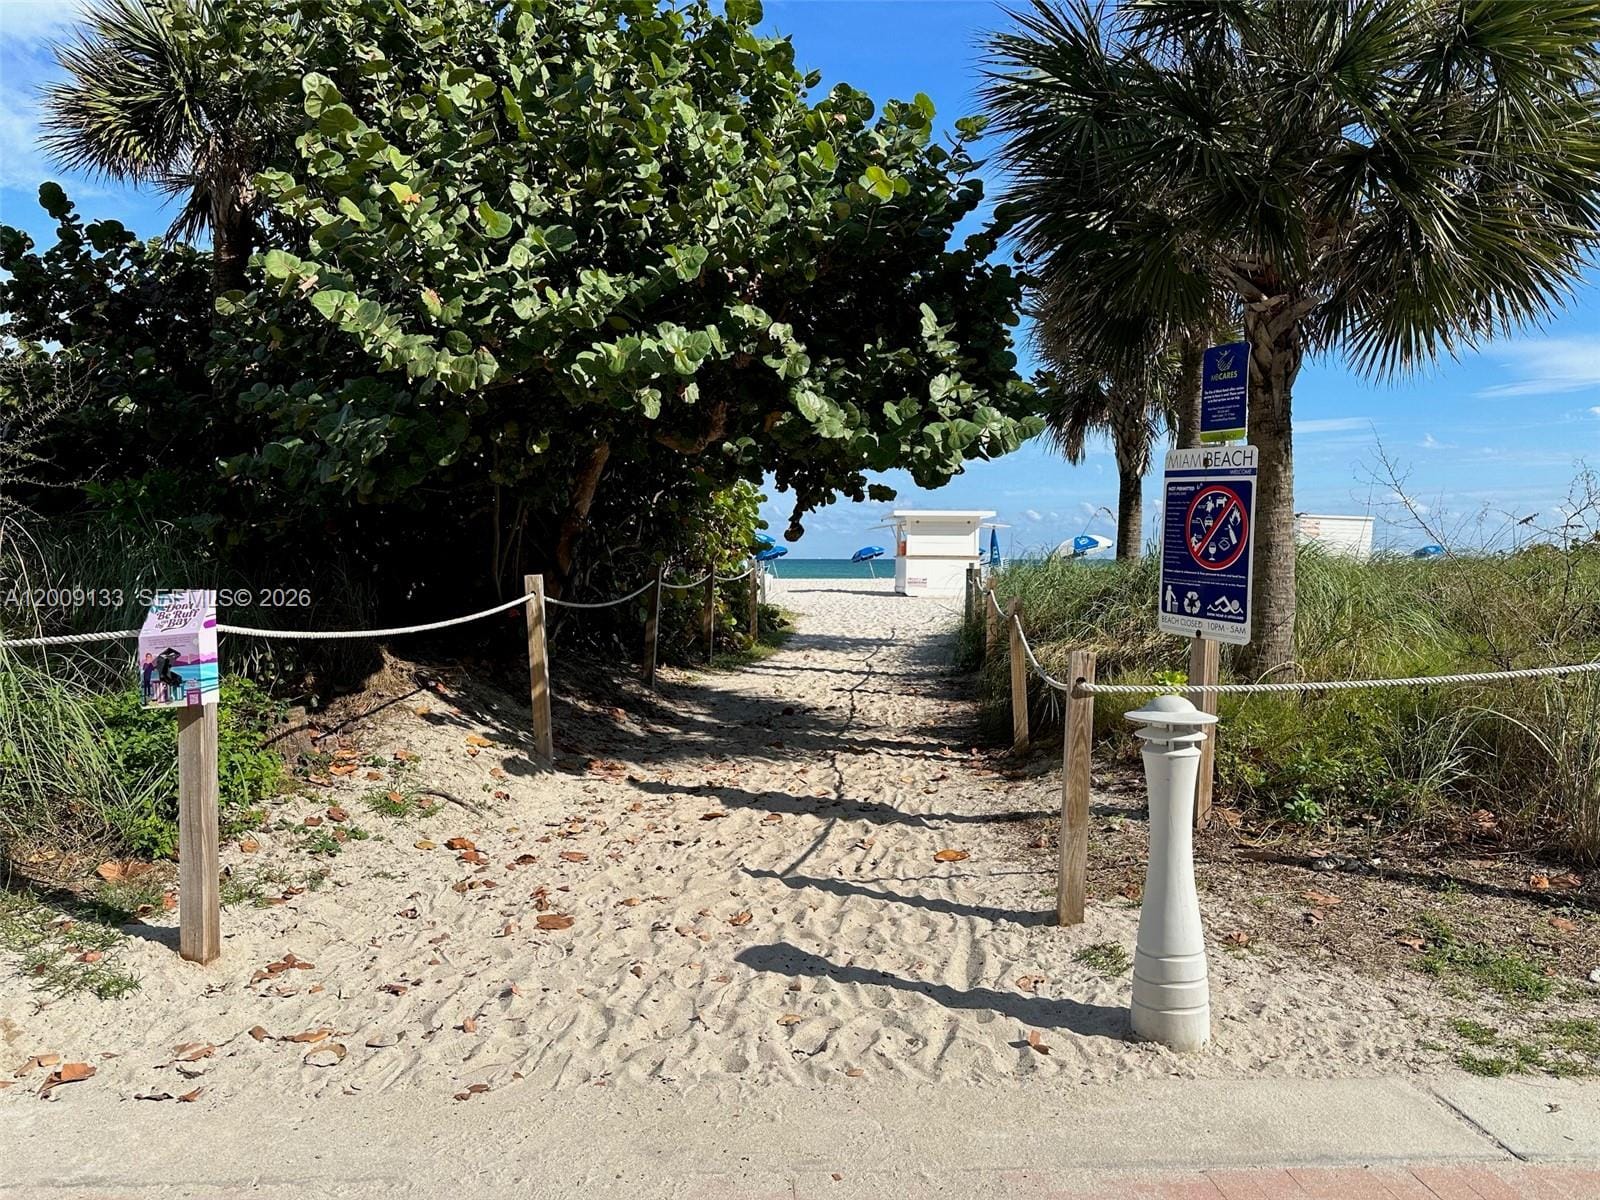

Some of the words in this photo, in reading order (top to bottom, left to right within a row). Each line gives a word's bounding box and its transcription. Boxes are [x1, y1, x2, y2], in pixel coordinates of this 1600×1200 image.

[157, 611, 171, 621] Be
[166, 617, 192, 630] Bay
[1161, 615, 1179, 625] BEACH
[1181, 618, 1202, 628] CLOSED
[1208, 622, 1225, 632] 10PM
